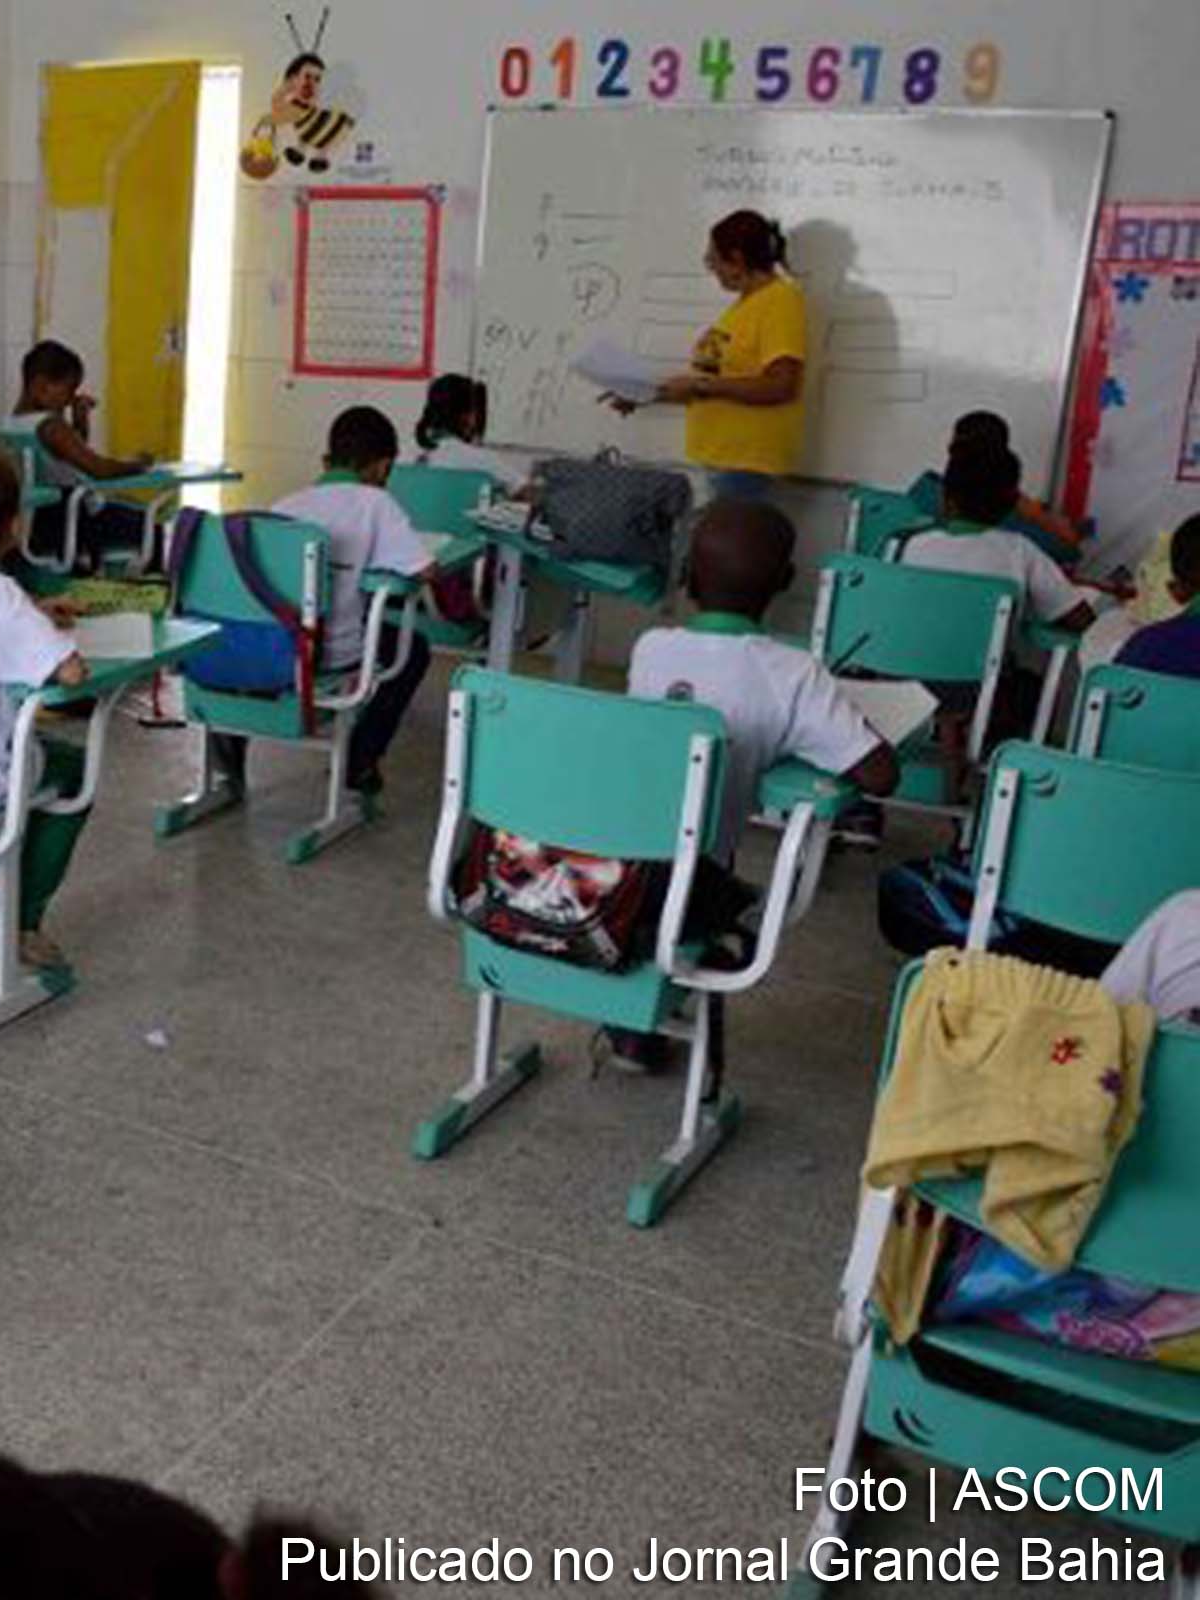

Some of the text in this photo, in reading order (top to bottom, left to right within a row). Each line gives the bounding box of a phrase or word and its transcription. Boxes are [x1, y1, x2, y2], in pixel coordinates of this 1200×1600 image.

[500, 37, 999, 105] 0 1 2 3 4 5 6 7 8 9
